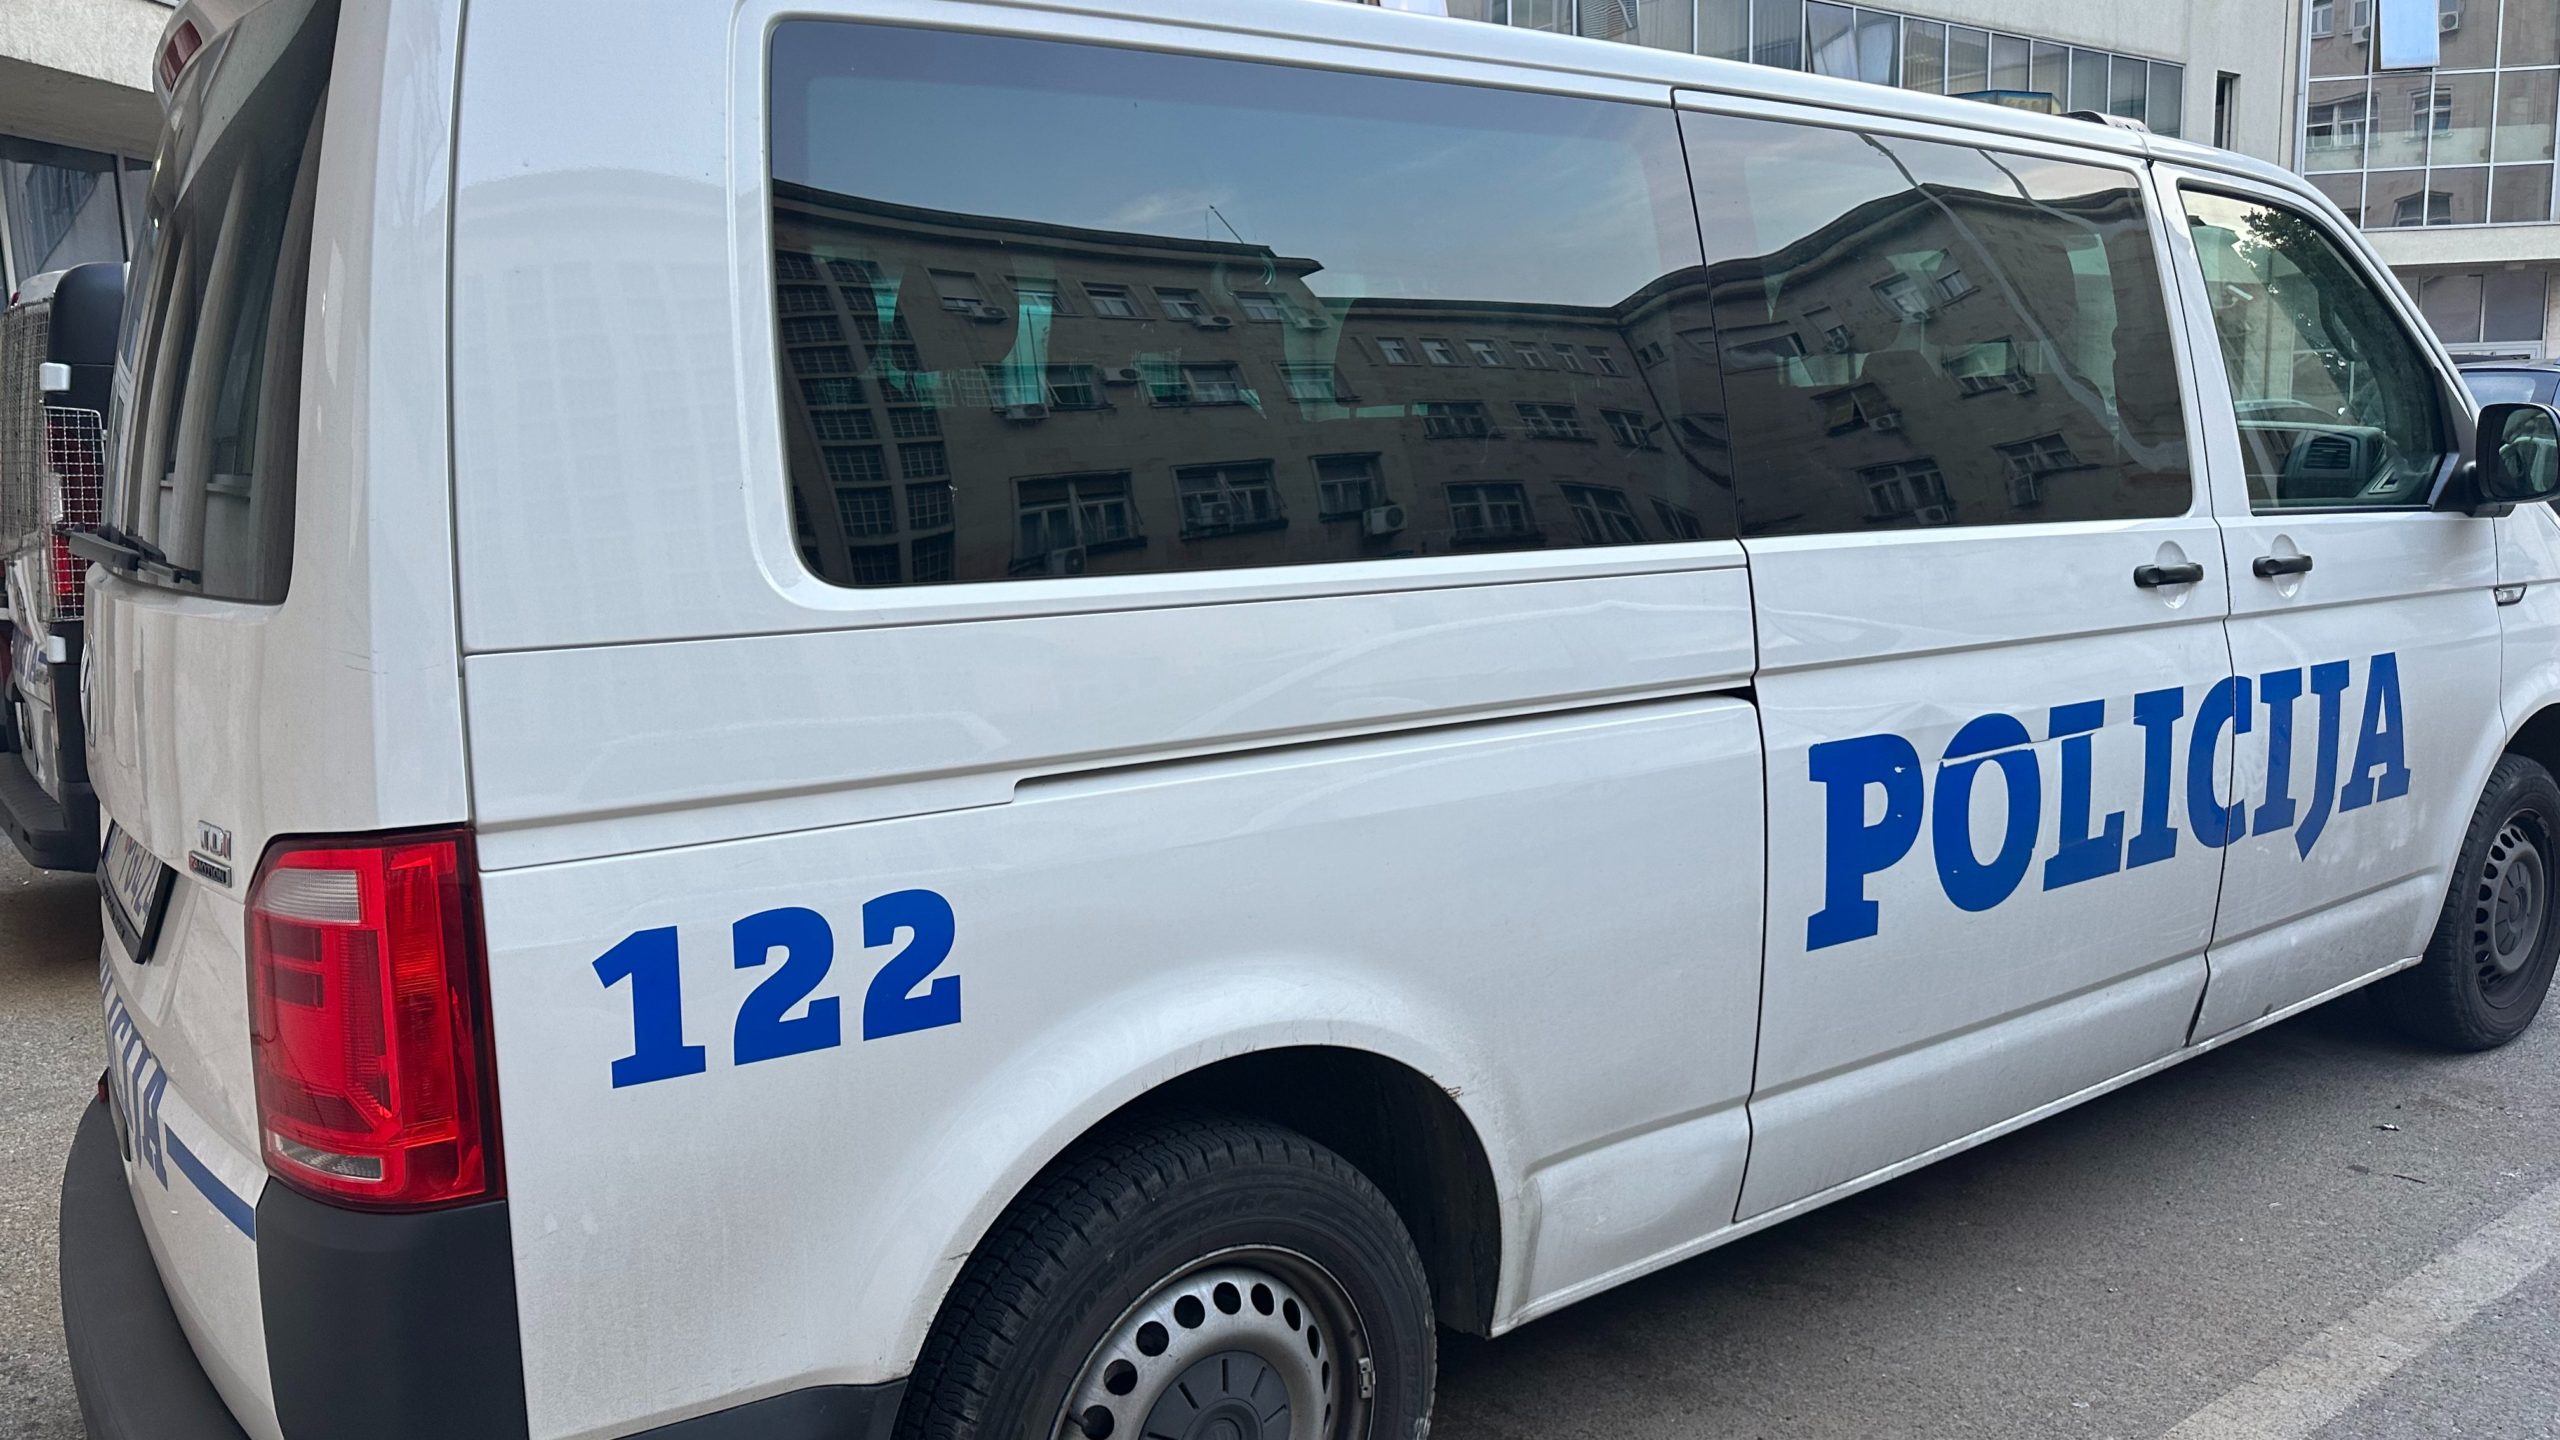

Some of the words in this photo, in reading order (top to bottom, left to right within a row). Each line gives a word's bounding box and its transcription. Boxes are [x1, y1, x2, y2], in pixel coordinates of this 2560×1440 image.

[198, 820, 231, 860] TDI
[1807, 652, 2410, 952] POLICIJA
[592, 888, 961, 1088] 122
